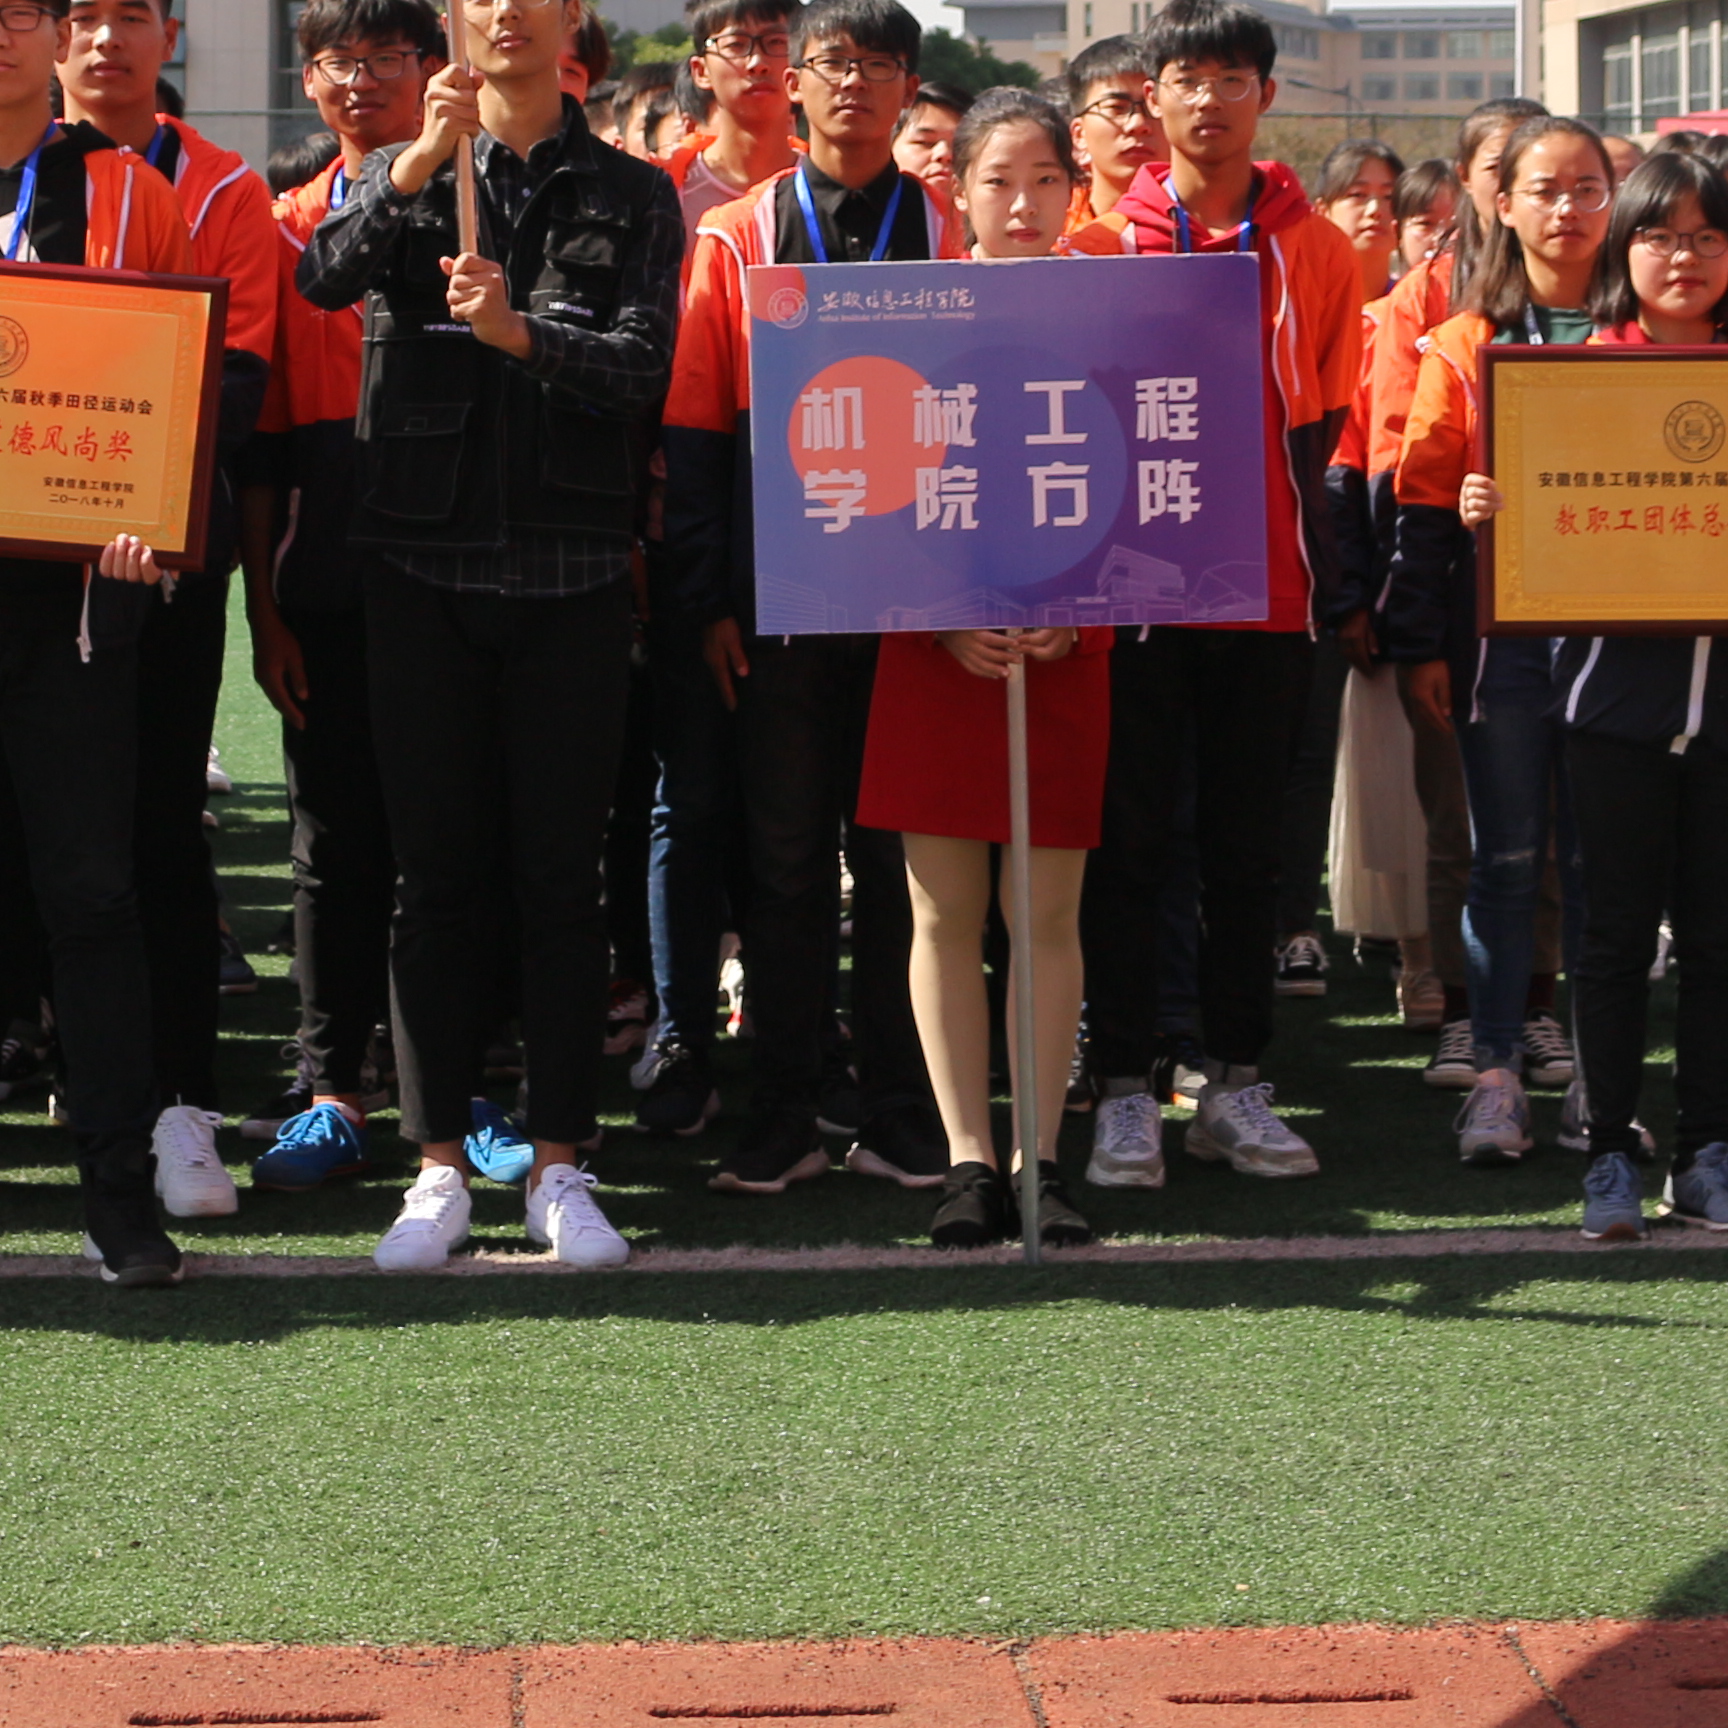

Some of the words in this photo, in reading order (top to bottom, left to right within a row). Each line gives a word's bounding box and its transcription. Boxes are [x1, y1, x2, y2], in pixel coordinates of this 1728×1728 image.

[42, 476, 135, 494] 安徽信息工程学院
